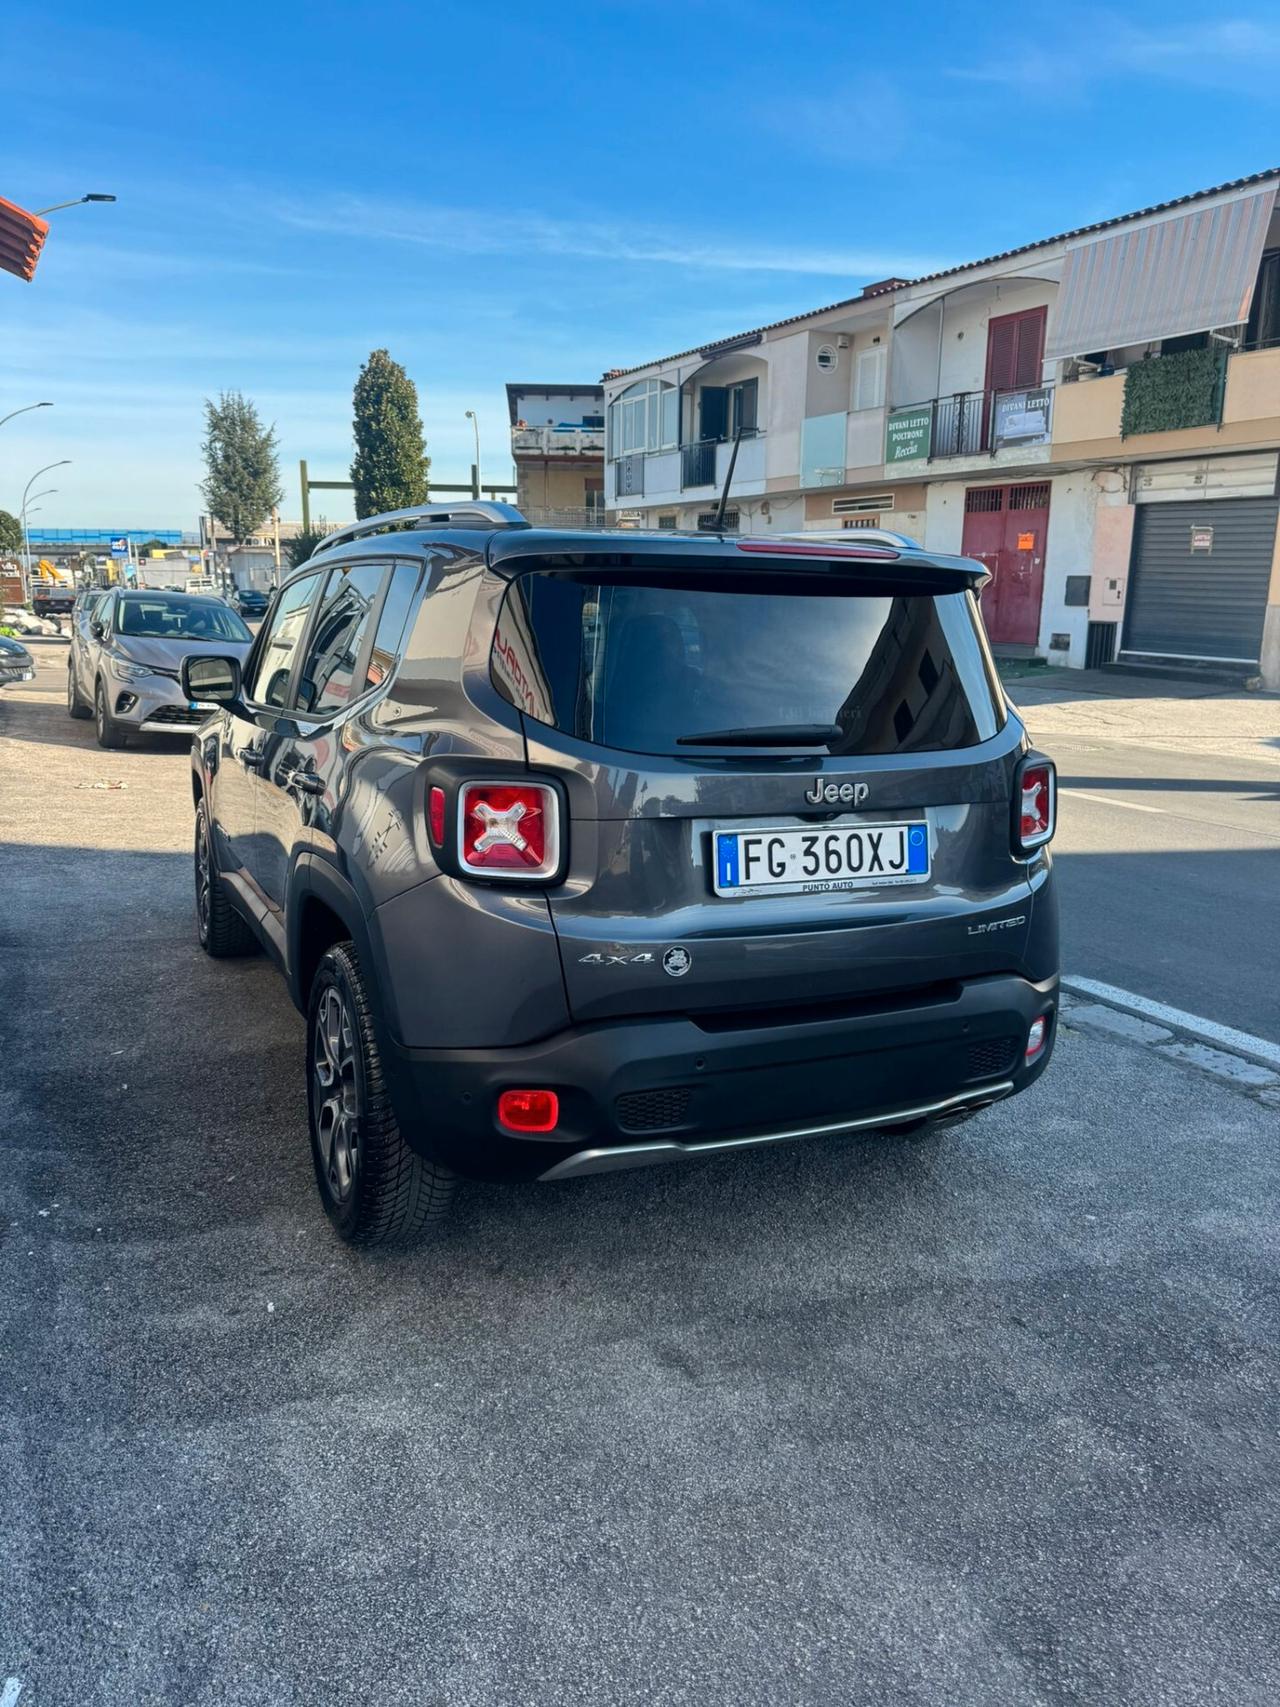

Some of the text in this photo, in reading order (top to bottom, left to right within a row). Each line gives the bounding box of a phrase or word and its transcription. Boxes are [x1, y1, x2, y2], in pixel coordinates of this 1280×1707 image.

[1027, 398, 1050, 409] LETTO
[909, 417, 929, 428] LETTO
[892, 429, 923, 442] POLTRONE
[806, 778, 870, 806] Jeep
[802, 881, 854, 892] PUNTO AUTO
[967, 915, 1026, 935] LIMITED
